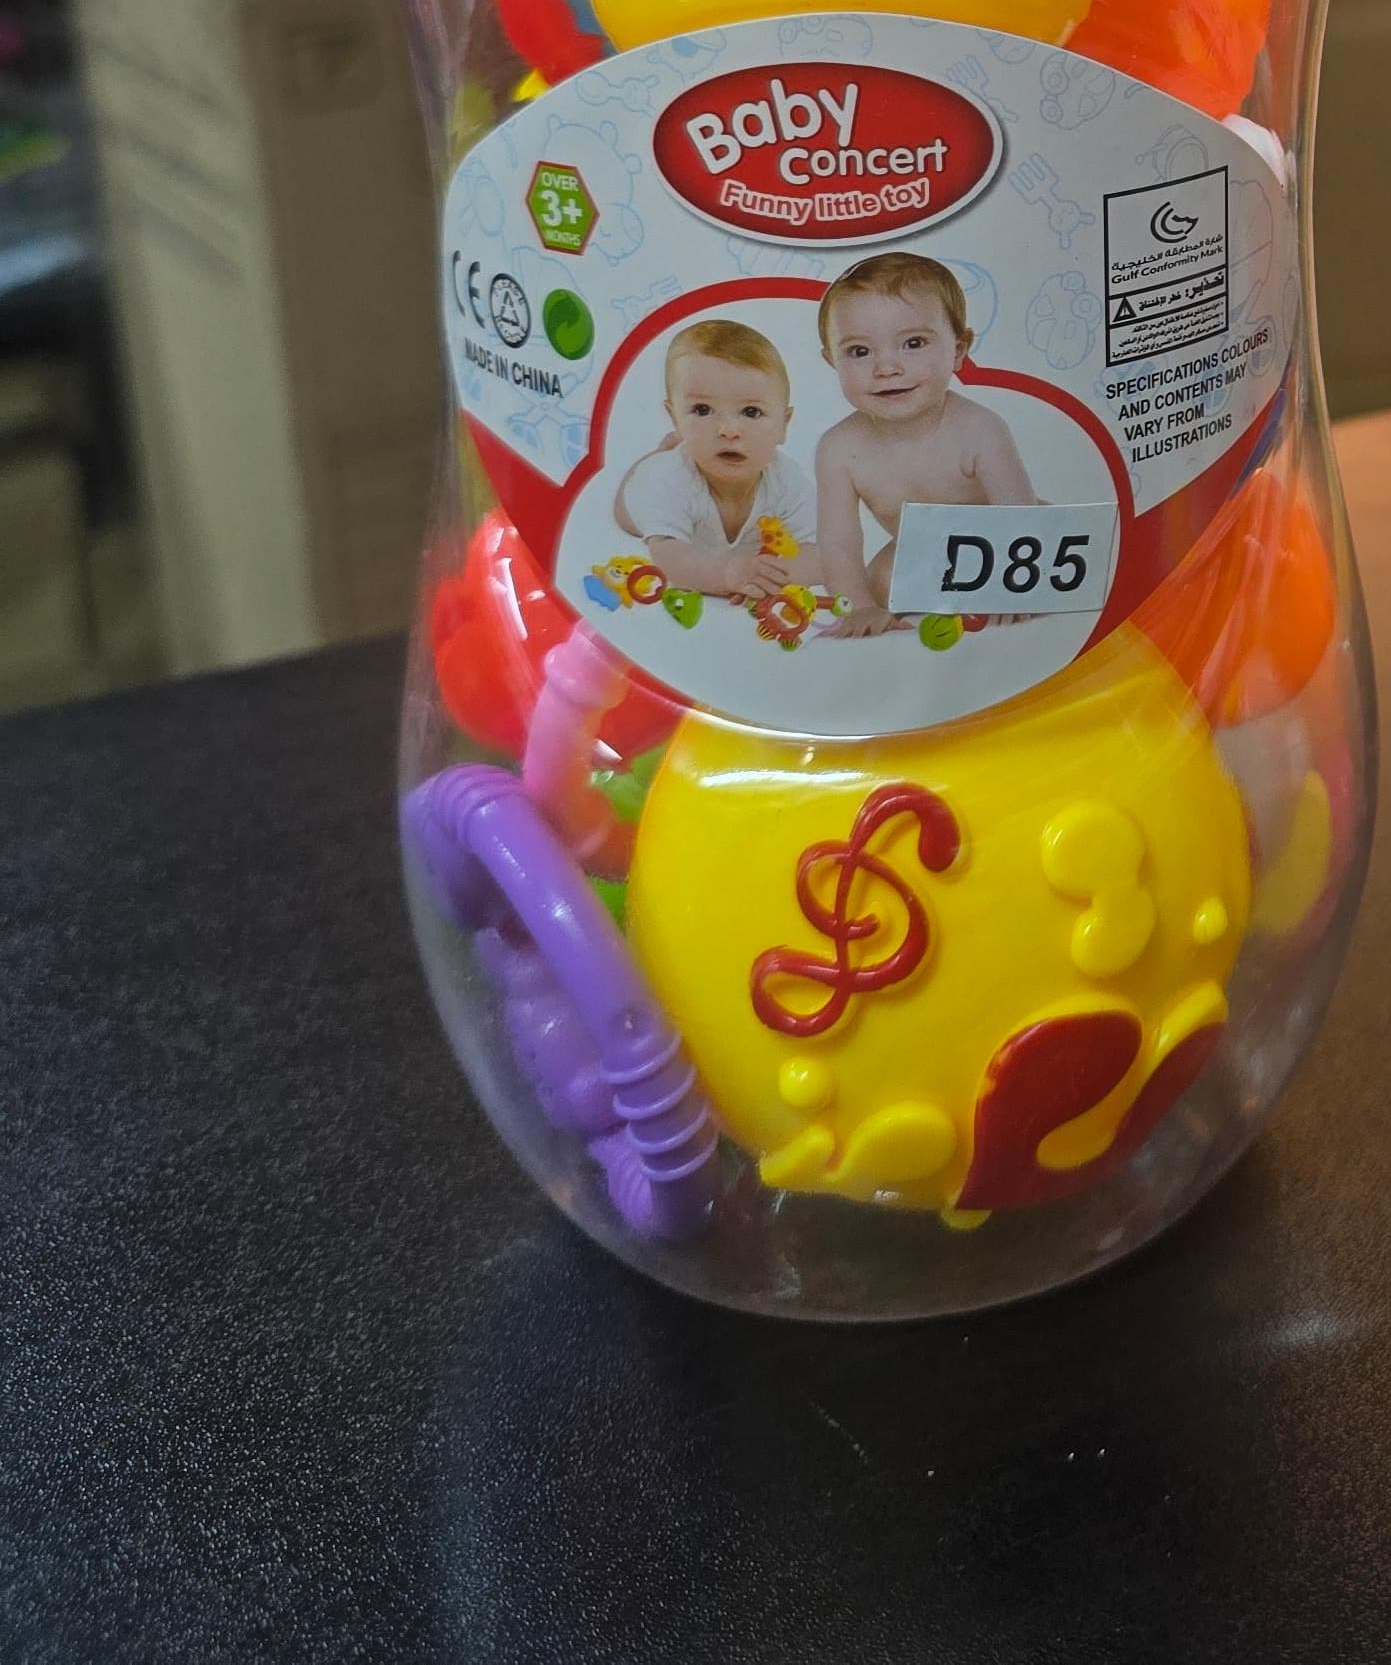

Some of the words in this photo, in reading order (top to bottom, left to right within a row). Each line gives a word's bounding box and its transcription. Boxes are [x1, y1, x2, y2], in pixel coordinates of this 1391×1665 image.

[686, 79, 858, 175] Baby
[541, 172, 579, 191] OVER
[721, 179, 812, 224] Funny
[814, 192, 881, 222] little
[881, 177, 929, 208] toy
[541, 190, 583, 226] 3+
[1111, 270, 1139, 284] Gulf
[1141, 253, 1200, 276] Conformity
[1200, 245, 1224, 258] Mark
[464, 337, 494, 373] MADE
[495, 356, 509, 381] IN
[512, 361, 564, 399] CHINA
[1106, 352, 1218, 399] SPECIFICATIONS
[1221, 328, 1269, 363] COLOURS
[1118, 400, 1151, 421] AND
[1154, 373, 1223, 410] CONTENTS
[1225, 361, 1248, 385] MAY
[1124, 416, 1164, 442] VARY
[1167, 403, 1205, 430] FROM
[1131, 413, 1233, 464] ILLUSTRATIONS
[941, 534, 1090, 593] D85
